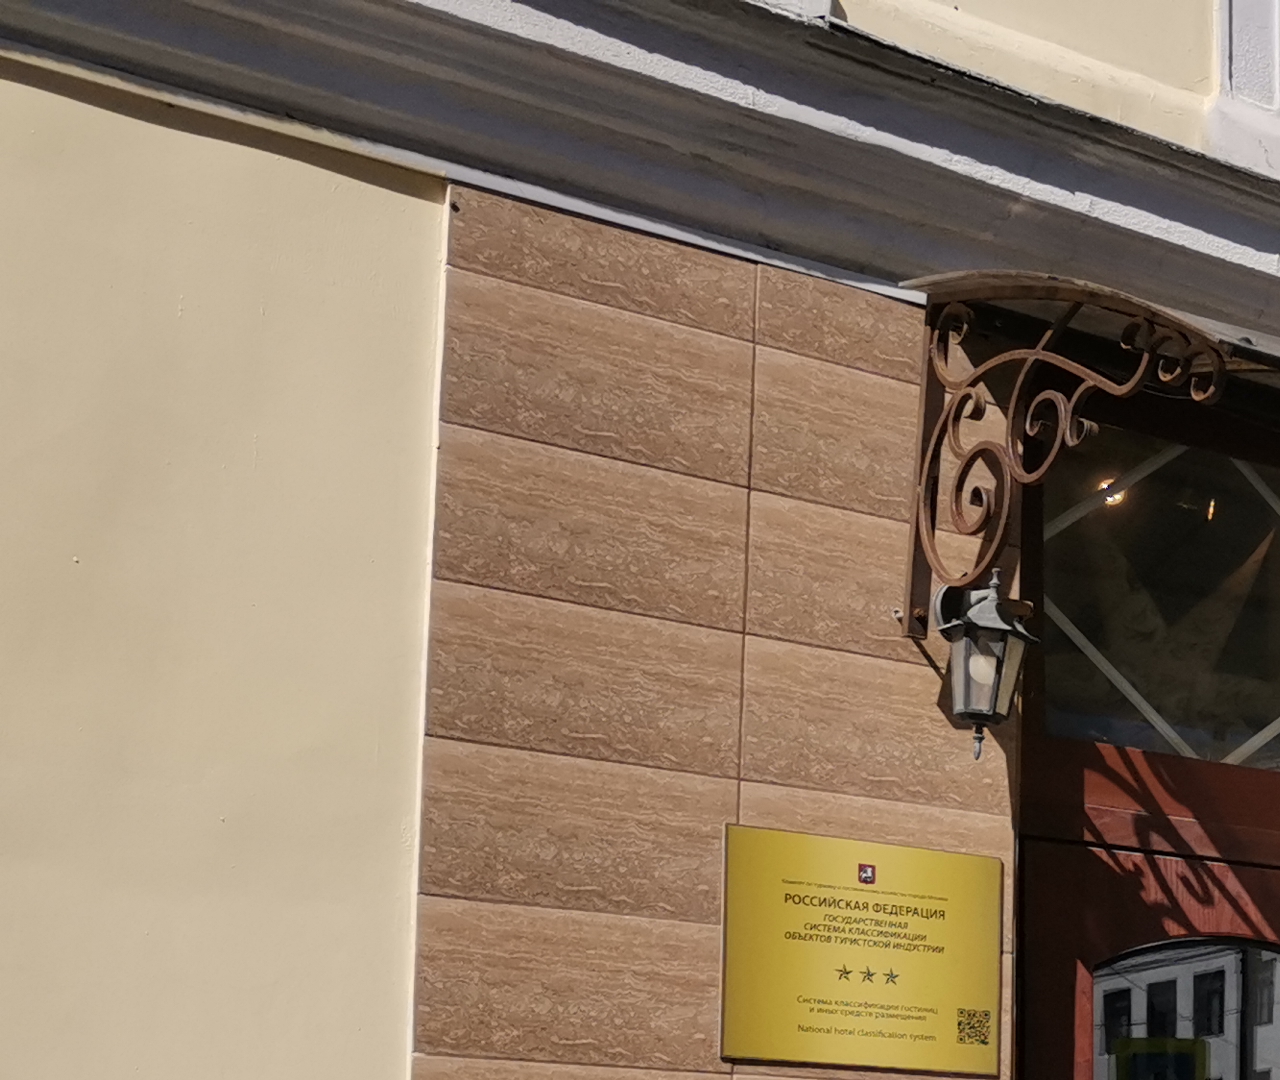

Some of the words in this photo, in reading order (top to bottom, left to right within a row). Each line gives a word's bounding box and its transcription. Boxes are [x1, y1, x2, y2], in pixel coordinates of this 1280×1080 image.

[784, 893, 869, 912] РОССИЙСКАЯ
[872, 903, 946, 920] ФЕДЕРАЦИЯ
[823, 914, 909, 929] ГОСУДАРСТВЕННАЯ
[804, 922, 846, 934] СИСТЕМА
[848, 927, 927, 942] КЛАССИФИКАЦИИ
[784, 931, 832, 943] ОБЪЕКТОВ
[892, 942, 945, 955] ИНДУСТРИИ
[797, 995, 833, 1006] Система
[797, 1024, 833, 1035] National
[834, 1027, 856, 1037] hotel
[857, 1028, 907, 1040] classification
[909, 1033, 937, 1043] system
